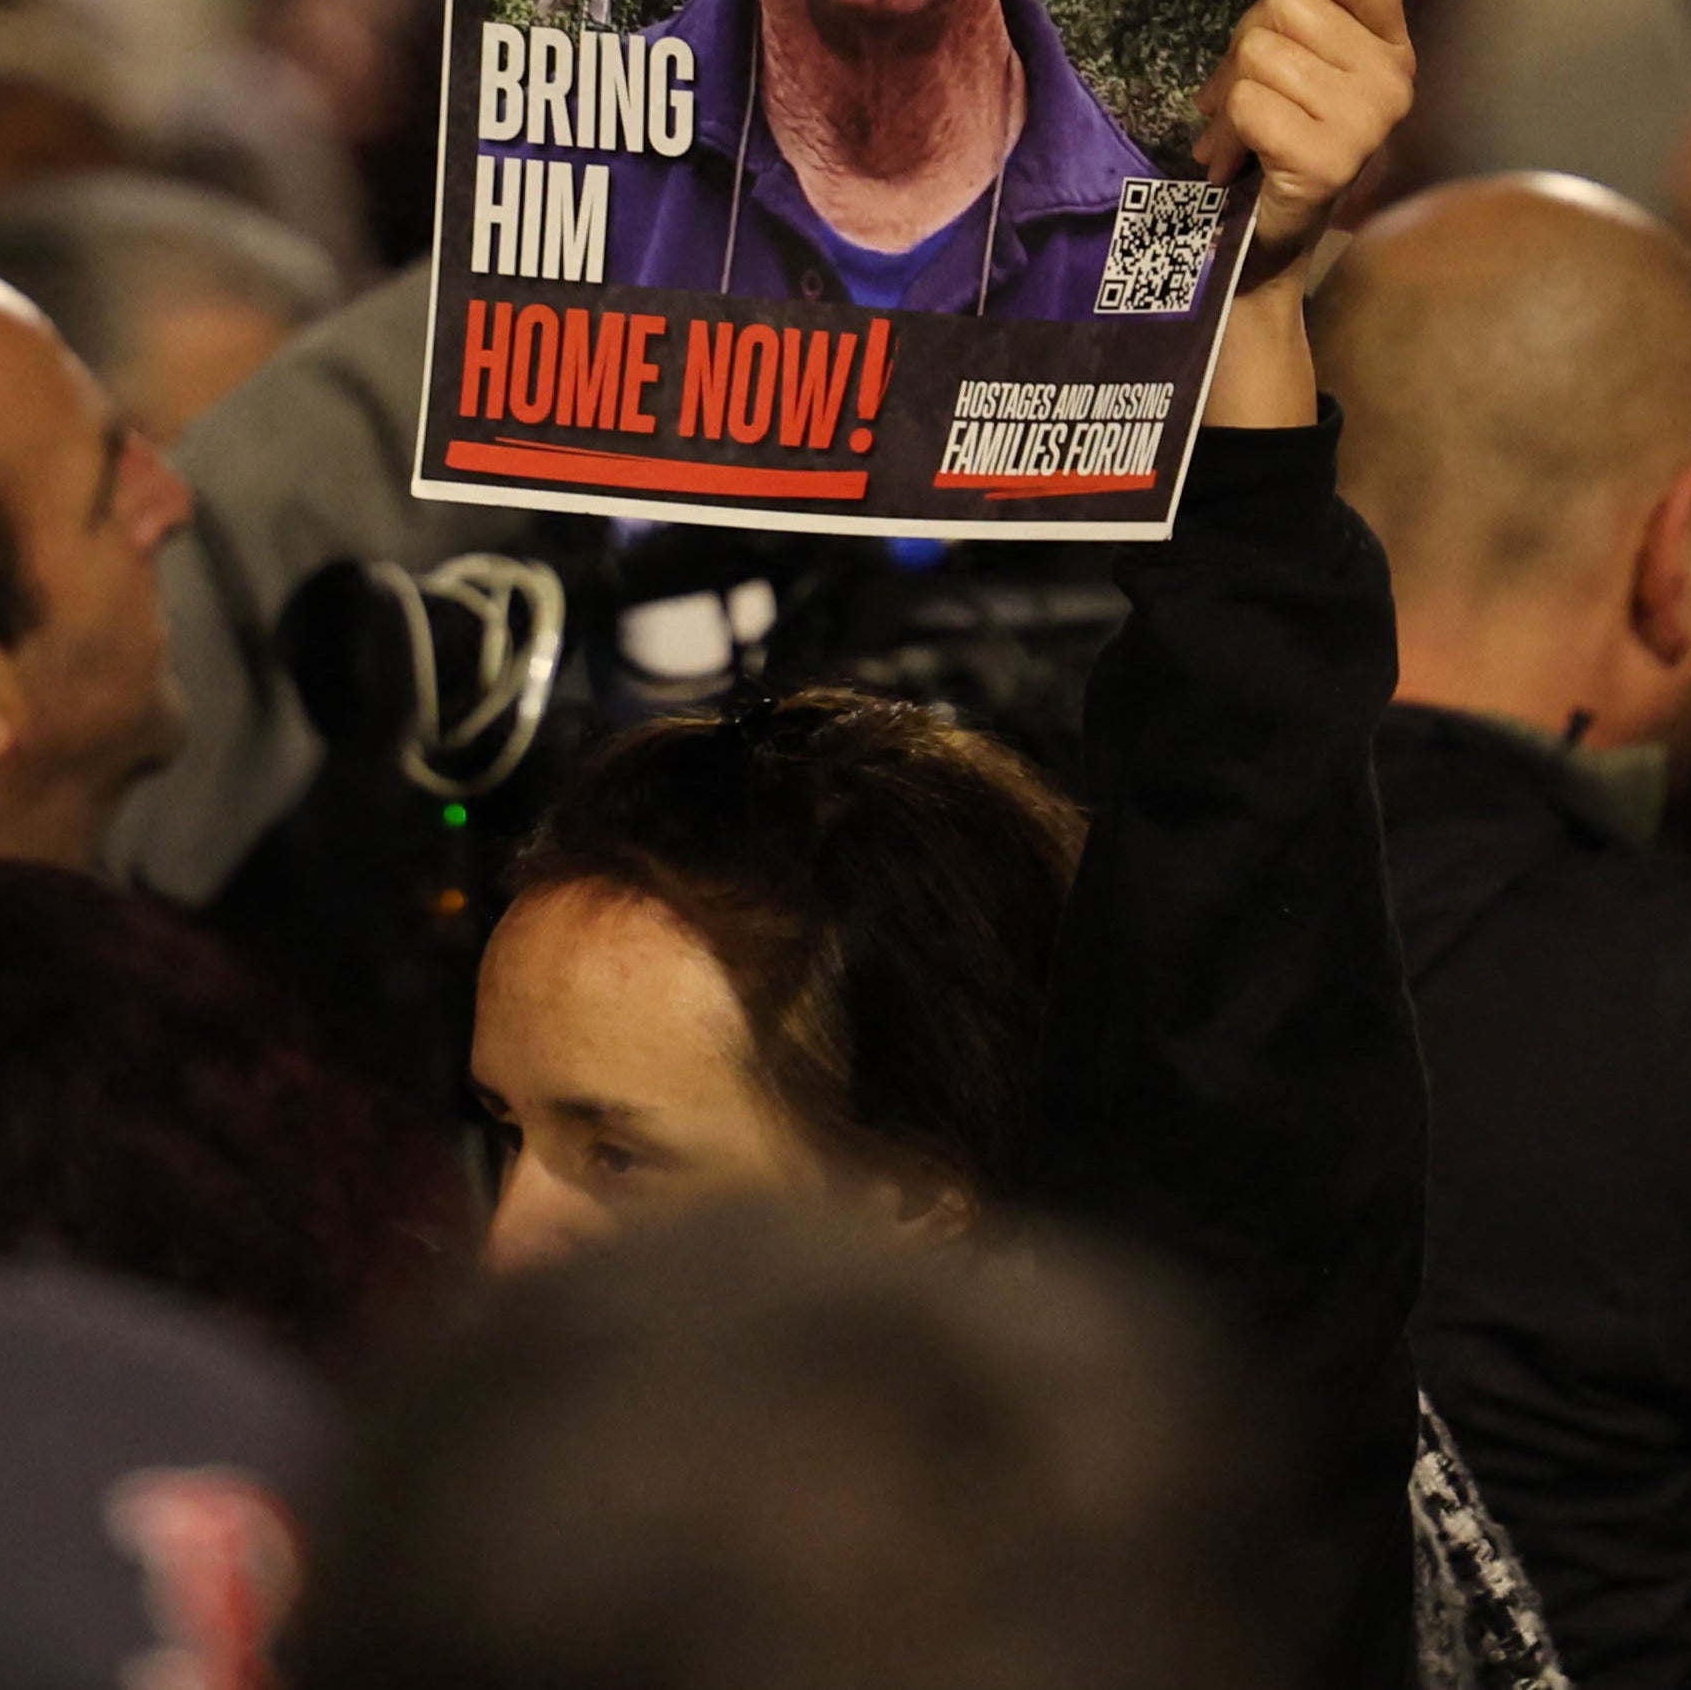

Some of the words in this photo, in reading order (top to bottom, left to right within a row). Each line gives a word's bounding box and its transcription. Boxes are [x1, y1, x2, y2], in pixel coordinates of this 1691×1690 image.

[478, 22, 694, 157] BRING
[471, 154, 610, 283] HIM
[459, 300, 667, 434] HOME
[678, 318, 892, 454] NOW!
[954, 380, 1056, 421] HOSTAGES
[1052, 383, 1095, 422] AND
[1090, 382, 1174, 421] MISSING
[940, 420, 1068, 477] FAMILIES
[1062, 421, 1164, 477] FORUM
